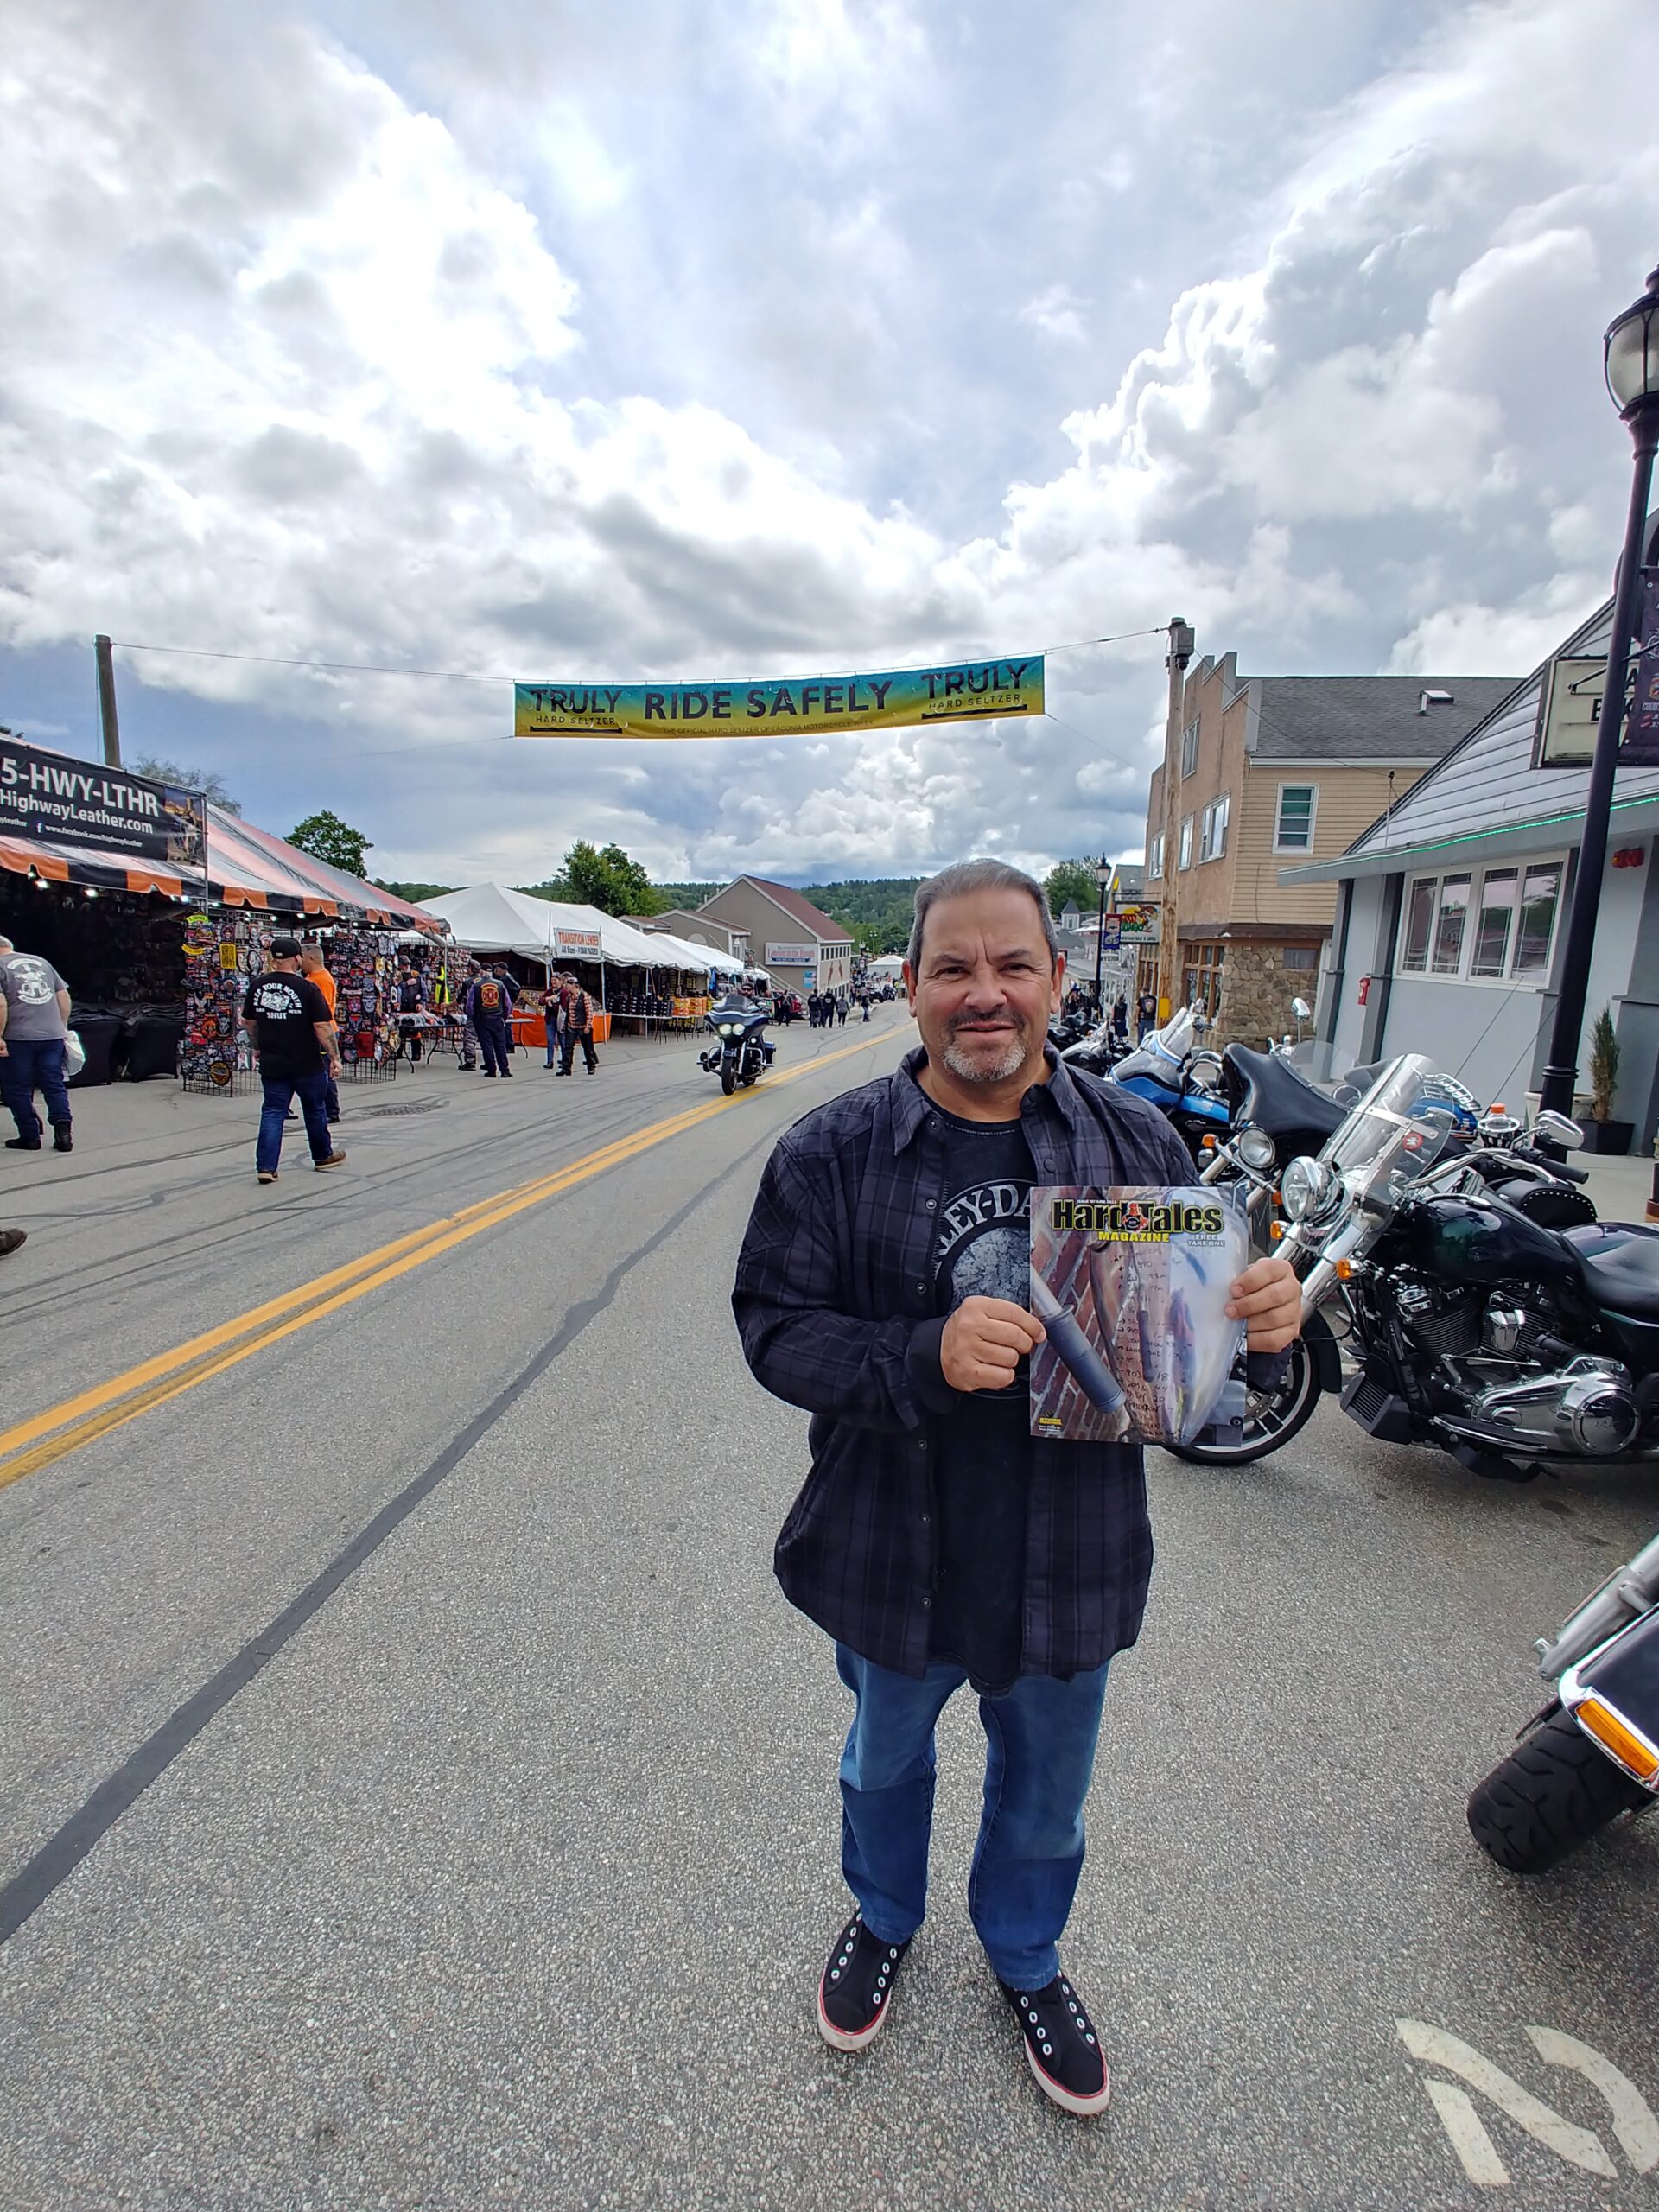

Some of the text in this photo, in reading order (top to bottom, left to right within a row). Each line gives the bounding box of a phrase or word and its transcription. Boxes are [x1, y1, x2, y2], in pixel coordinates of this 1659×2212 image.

[921, 664, 1027, 699] TRULY
[530, 689, 622, 714] TRULY
[645, 680, 892, 720] RIDE SAFELY
[929, 694, 1021, 709] HARD SELTZER
[536, 715, 615, 726] HARD SELTZER
[1, 757, 160, 817] 5-HWY-LTHR
[283, 985, 302, 1008] MOUTH
[1052, 1199, 1224, 1234] Hard Tales
[1098, 1231, 1170, 1243] MAGAZINE
